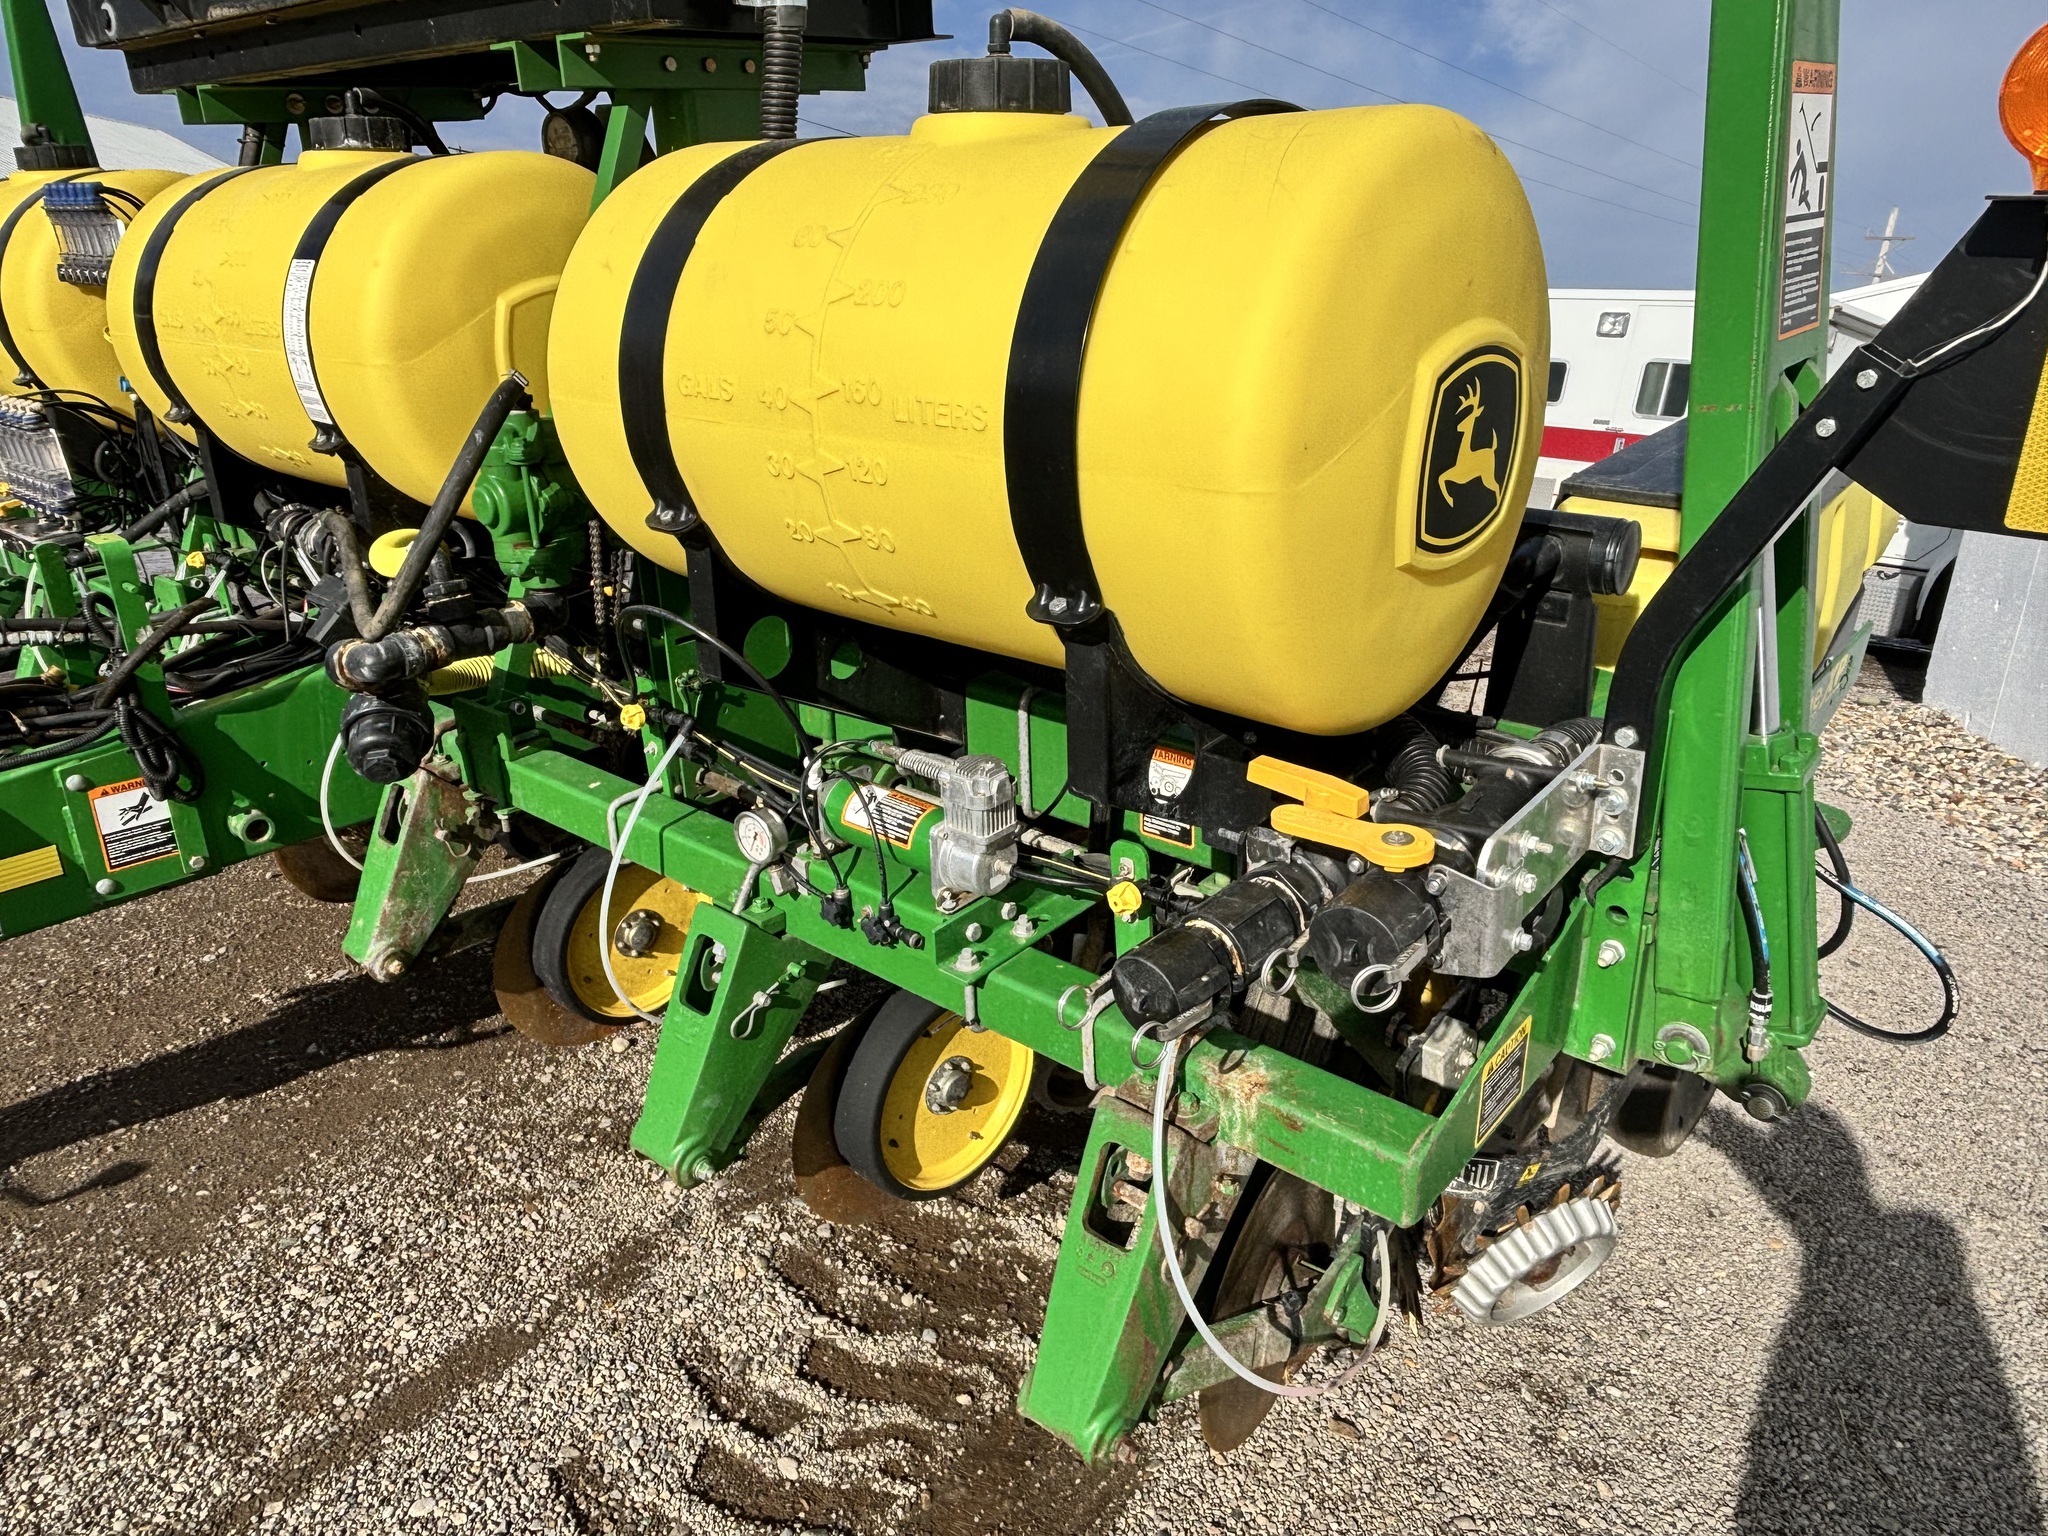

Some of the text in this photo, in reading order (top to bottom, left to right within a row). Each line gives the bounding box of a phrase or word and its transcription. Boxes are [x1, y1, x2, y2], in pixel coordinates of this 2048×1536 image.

[853, 278, 907, 309] 200
[763, 307, 796, 337] 50
[677, 373, 989, 433] GALS 40 160 LITERS
[765, 451, 890, 487] 30 120
[784, 517, 897, 554] 20 80
[1154, 749, 1192, 766] ARNING
[1495, 1024, 1527, 1067] CAUTION
